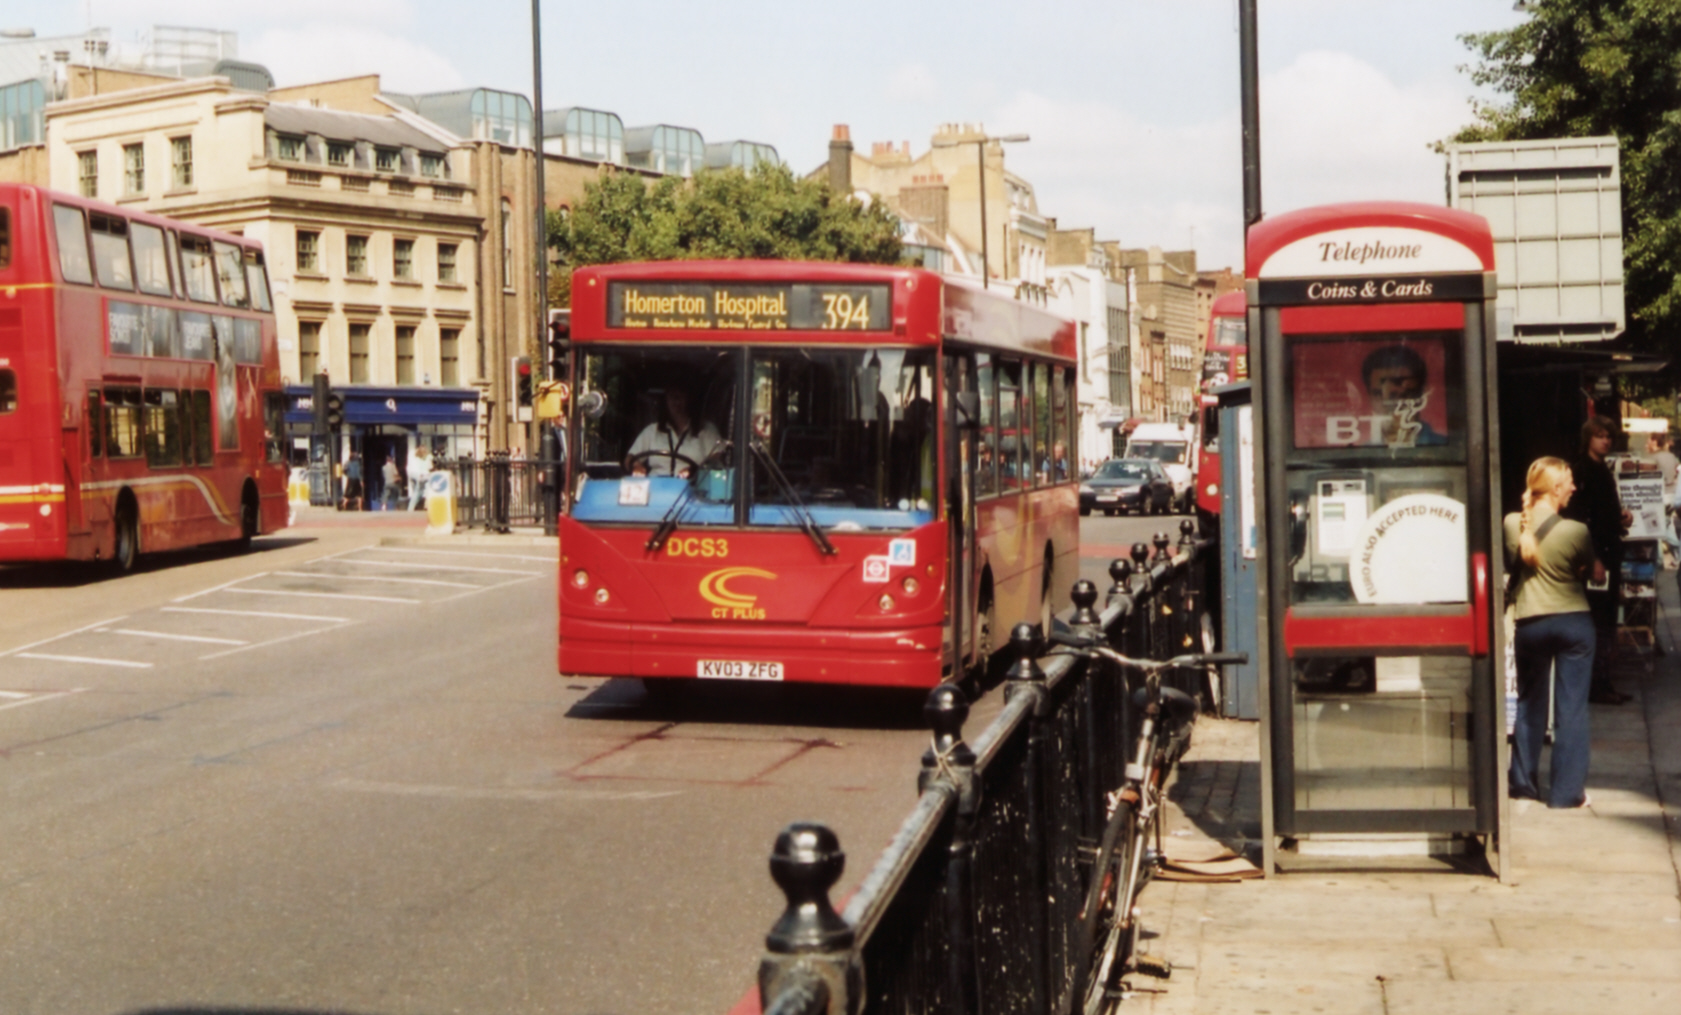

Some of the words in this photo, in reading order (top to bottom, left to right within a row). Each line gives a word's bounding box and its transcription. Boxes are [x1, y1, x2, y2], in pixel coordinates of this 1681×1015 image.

[1319, 240, 1422, 265] Telephone
[1307, 282, 1357, 300] Coins
[1360, 280, 1377, 298] &
[1381, 279, 1433, 297] Cards
[625, 289, 705, 314] Homerton
[715, 290, 787, 321] Hospital
[822, 294, 870, 330] 394
[1326, 415, 1394, 445] BT
[1375, 505, 1427, 538] ACCEPTED
[1429, 506, 1459, 524] HERE
[667, 537, 729, 557] DCS3
[1361, 535, 1378, 566] ALSO
[1361, 566, 1378, 598] EURO
[711, 607, 729, 619] CT
[733, 607, 766, 620] PLUS
[703, 660, 743, 677] KV03
[748, 662, 779, 679] ZFG
